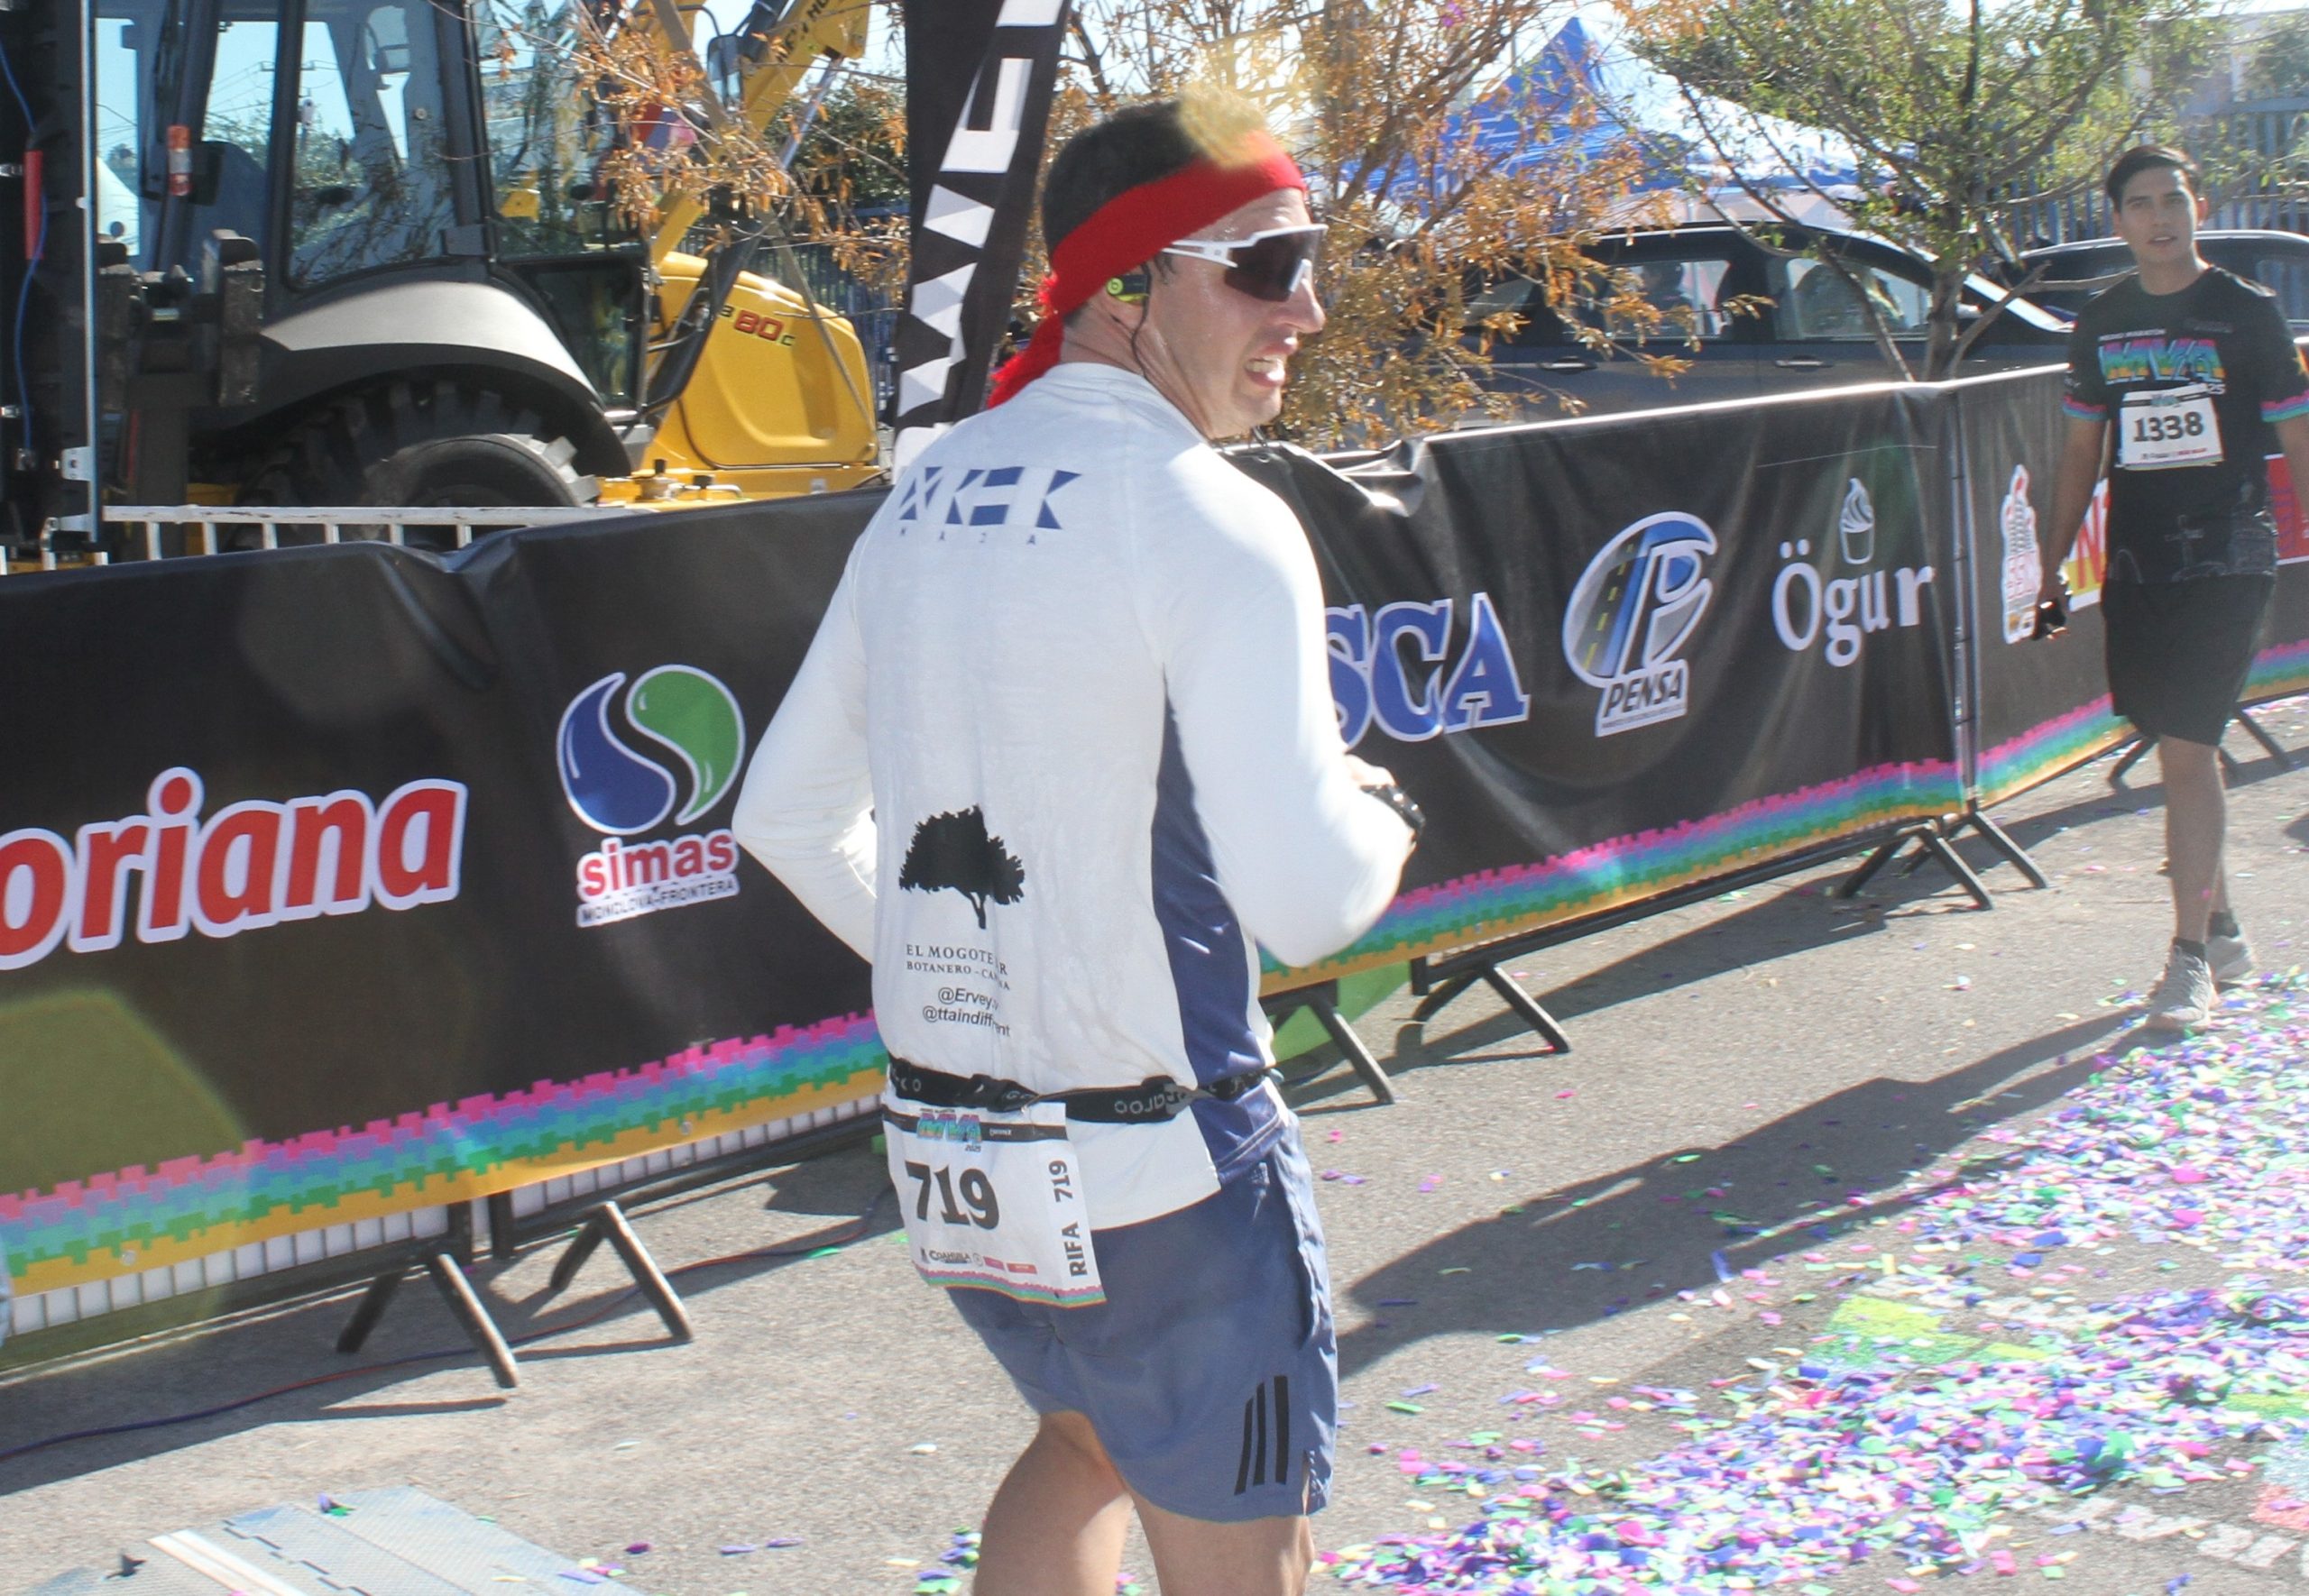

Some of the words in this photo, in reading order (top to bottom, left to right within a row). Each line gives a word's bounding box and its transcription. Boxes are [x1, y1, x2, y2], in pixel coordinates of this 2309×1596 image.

[2133, 411, 2203, 443] 1338
[1772, 539, 1935, 666] Ögur
[1603, 668, 1683, 719] PENSA
[582, 831, 736, 899] simas
[906, 944, 924, 958] EL
[928, 945, 994, 965] MOGOTE
[906, 960, 971, 975] BOTANERO
[905, 1160, 1000, 1231] 719
[1048, 1160, 1073, 1203] 719
[1062, 1221, 1089, 1278] RIFA
